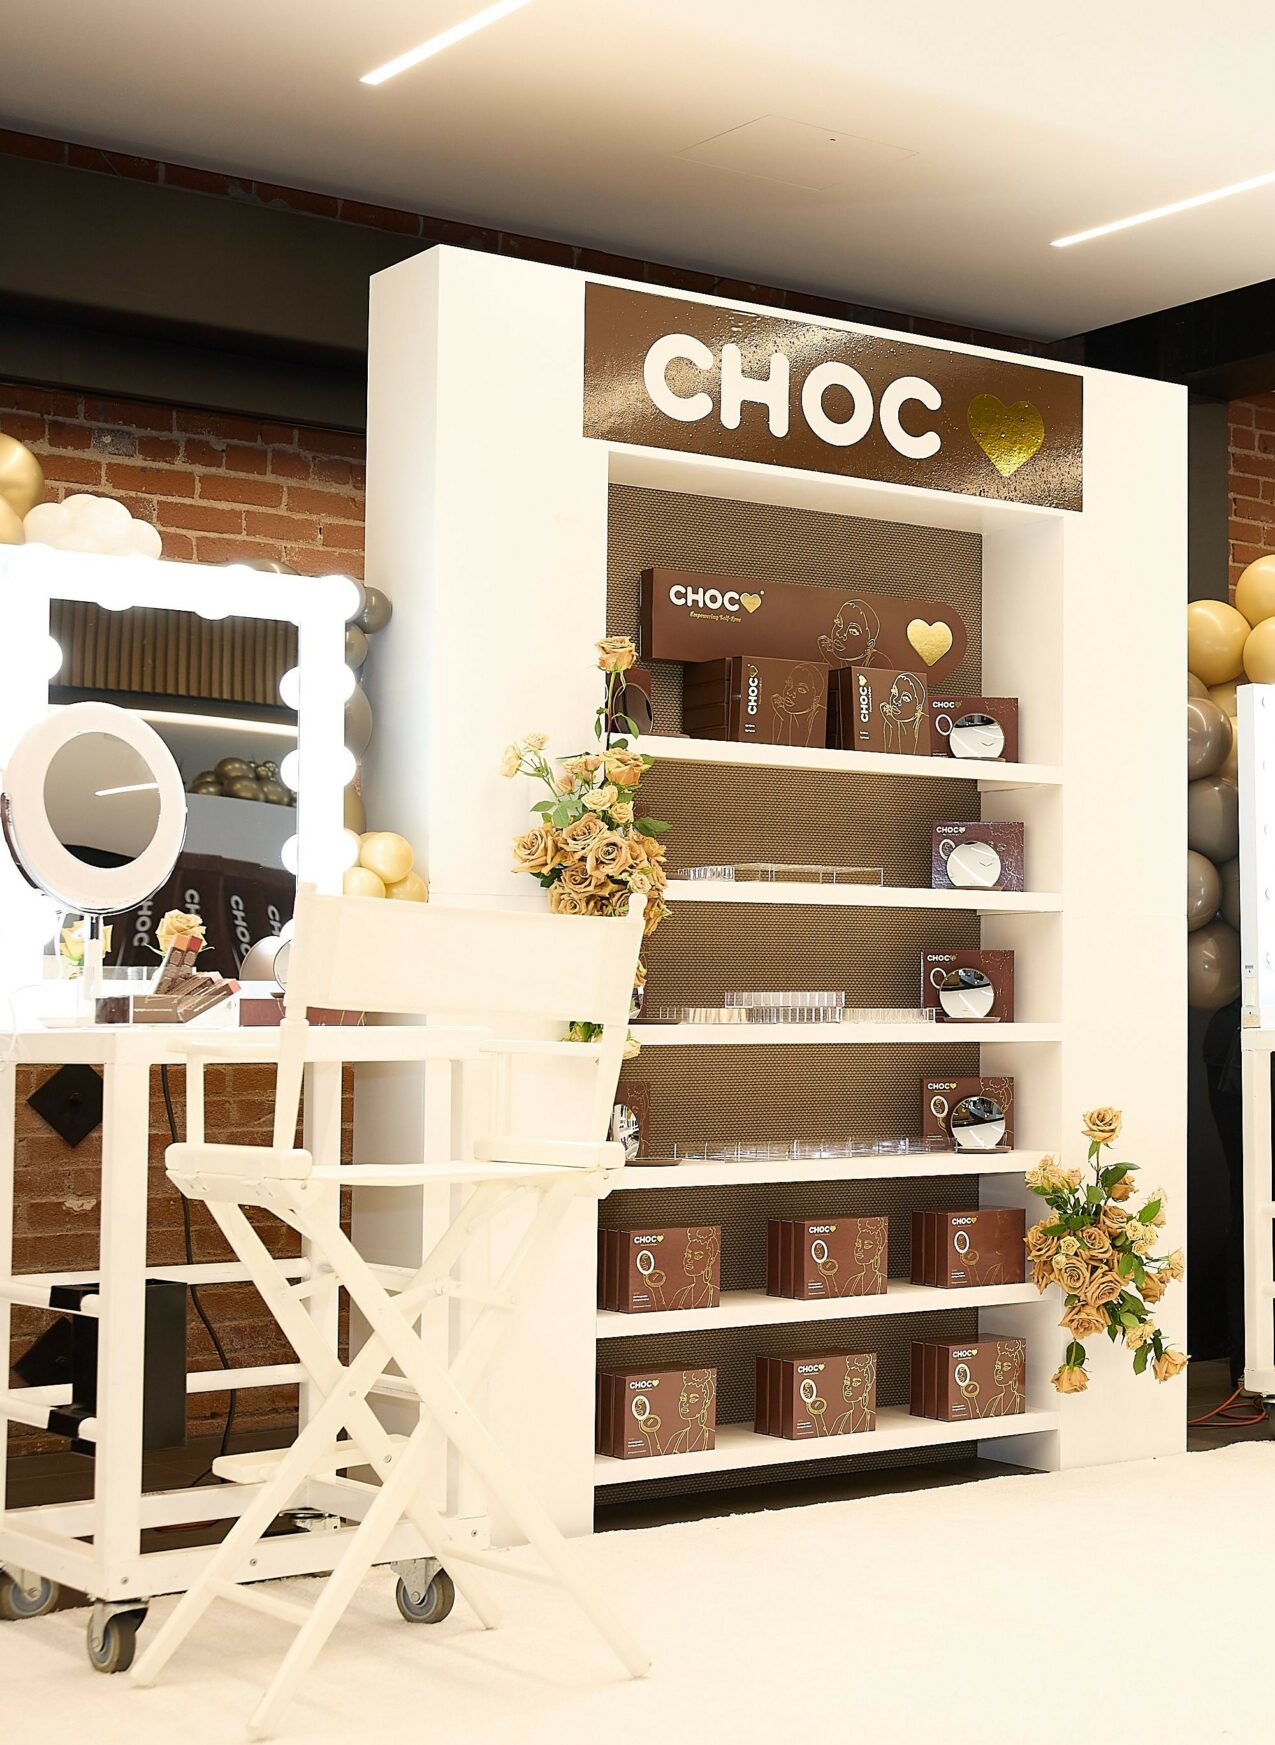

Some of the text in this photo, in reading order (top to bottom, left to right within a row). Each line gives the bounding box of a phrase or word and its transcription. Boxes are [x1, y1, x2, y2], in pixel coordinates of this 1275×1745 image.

[644, 333, 942, 459] CHOC
[669, 585, 740, 612] CHOC
[747, 677, 759, 715] CHOC
[859, 686, 869, 722] CHOC
[132, 899, 153, 946] HOC
[927, 954, 950, 962] CHOC
[927, 1082, 950, 1090] CHOC
[951, 1217, 972, 1225] CHOC
[808, 1225, 830, 1234] CHOC
[633, 1235, 657, 1244] CHOC
[952, 1349, 972, 1358] CHOC
[797, 1364, 819, 1373] CHOC
[629, 1380, 653, 1389] CHOC
